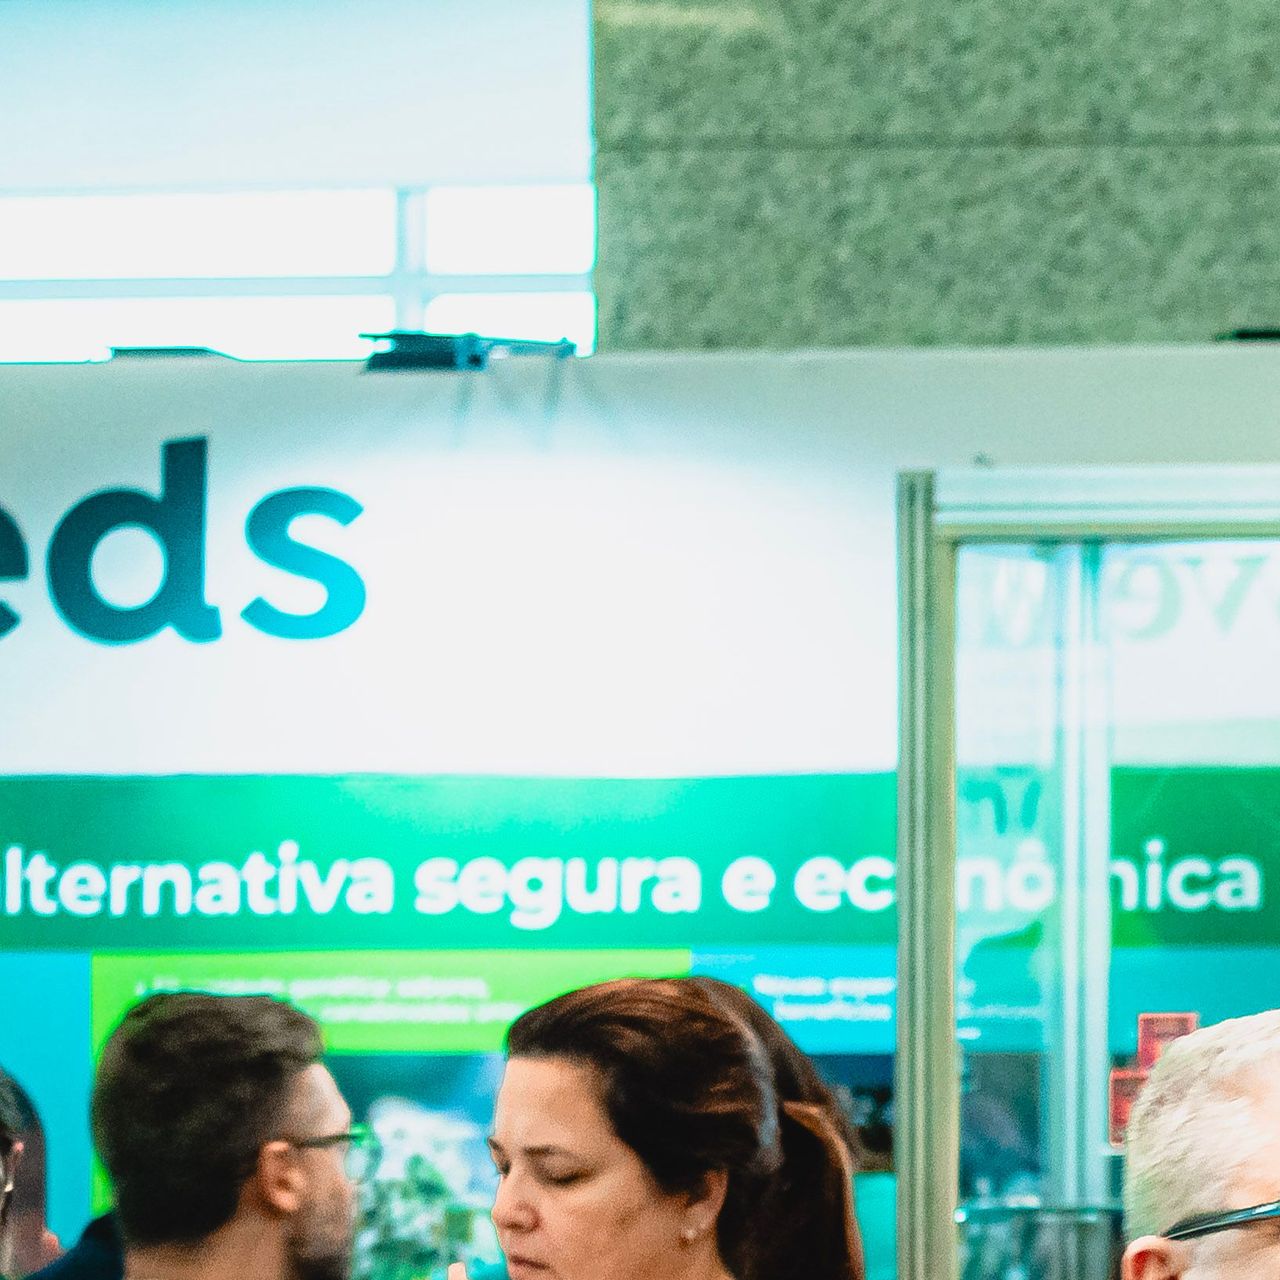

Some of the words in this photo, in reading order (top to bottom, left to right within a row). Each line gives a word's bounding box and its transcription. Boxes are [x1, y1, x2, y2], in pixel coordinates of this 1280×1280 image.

[0, 434, 366, 645] ds
[413, 853, 702, 930] segura
[722, 855, 776, 913] e
